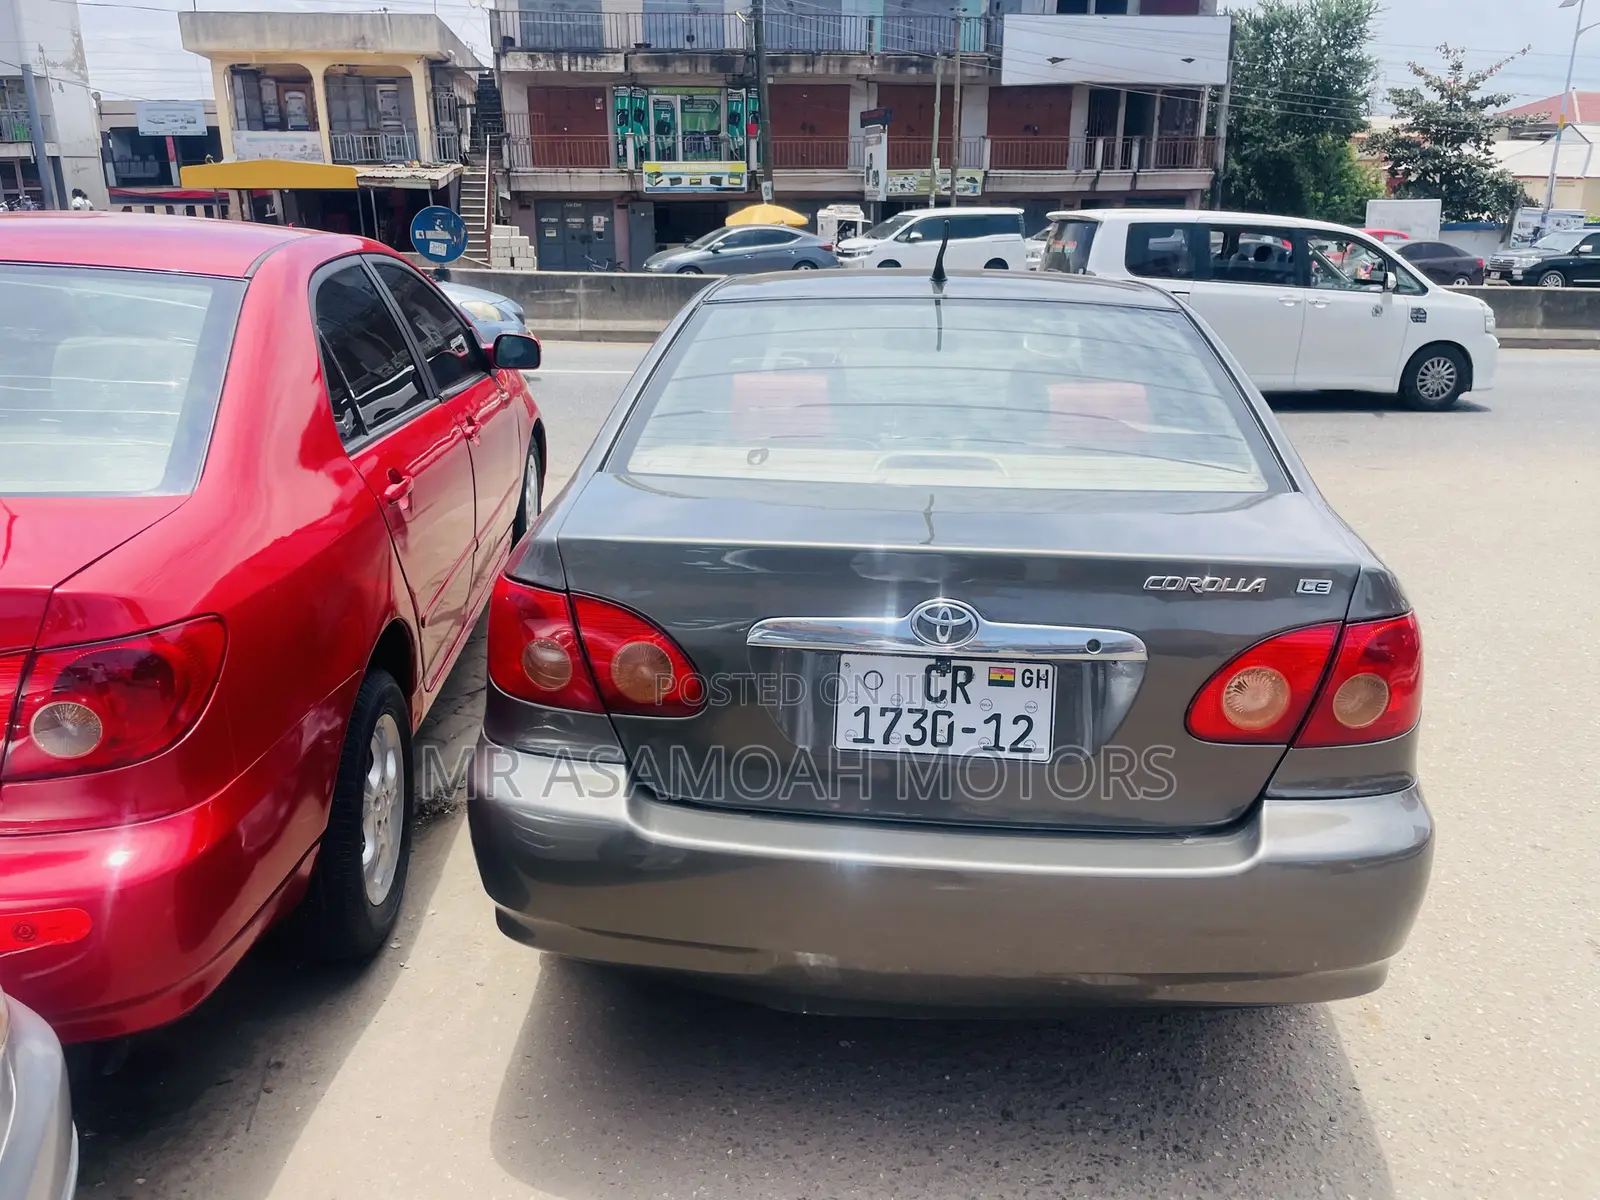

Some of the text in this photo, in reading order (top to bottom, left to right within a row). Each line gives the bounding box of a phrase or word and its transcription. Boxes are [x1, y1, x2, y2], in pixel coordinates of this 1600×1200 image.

[1143, 576, 1330, 593] COROLLA LE
[924, 664, 974, 704] CR
[1021, 668, 1049, 689] GH
[852, 705, 1034, 753] 1730-12
